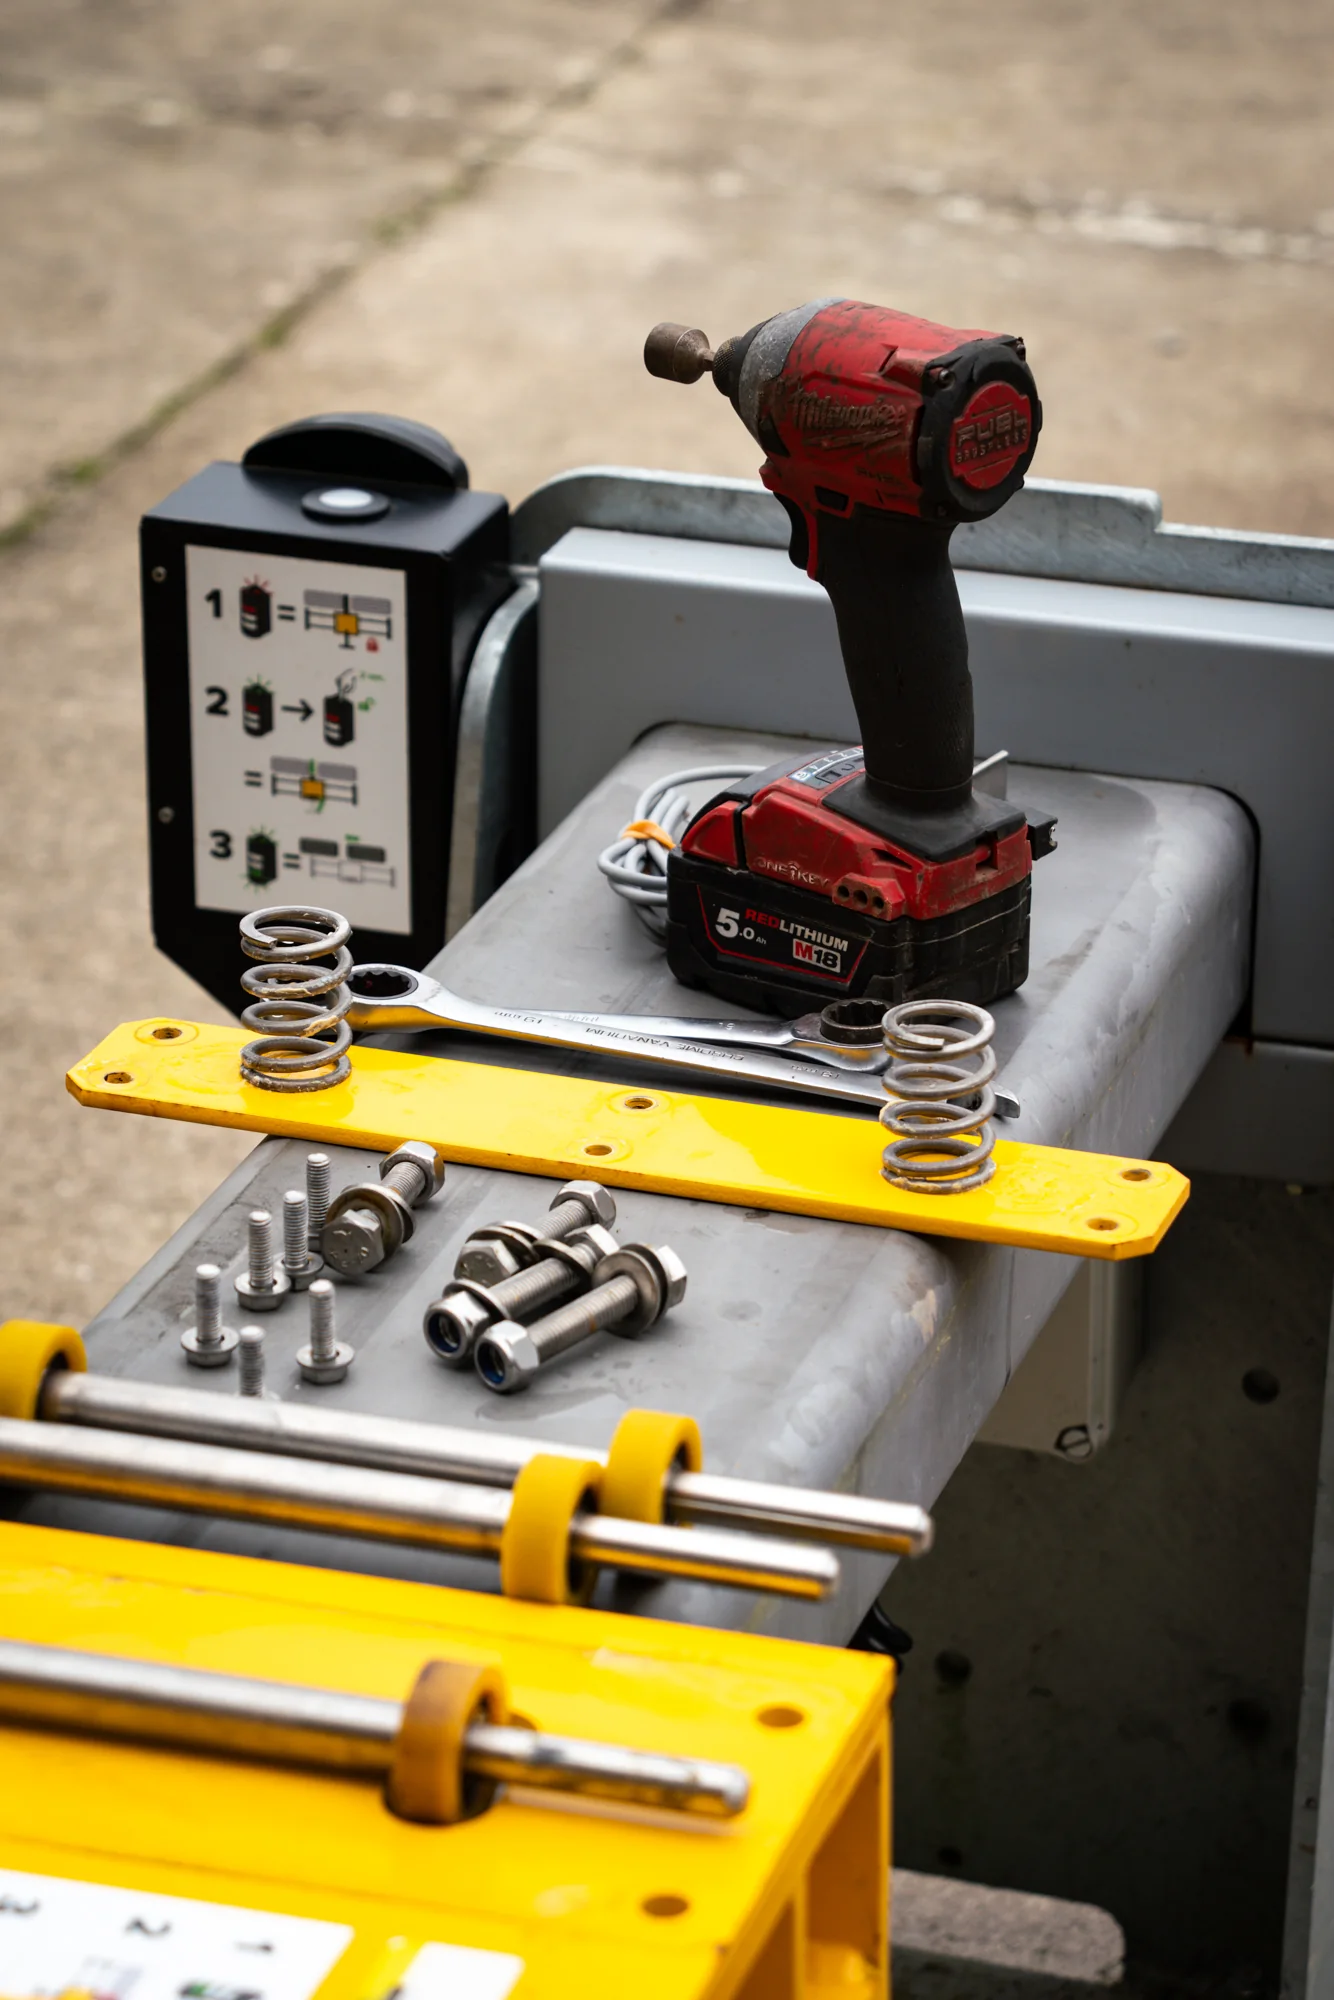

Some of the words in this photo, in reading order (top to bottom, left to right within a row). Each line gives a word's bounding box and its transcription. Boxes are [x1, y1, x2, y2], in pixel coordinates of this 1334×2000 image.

[955, 409, 1028, 448] FUEL
[955, 428, 1028, 464] BRUSHLESS
[204, 588, 223, 619] 1
[204, 686, 229, 717] 2
[208, 830, 233, 860] 3
[715, 907, 755, 940] 5.0
[755, 936, 767, 945] Ah
[744, 908, 849, 952] REDLITHIUM
[794, 940, 839, 969] M18
[676, 1043, 745, 1061] CHROME
